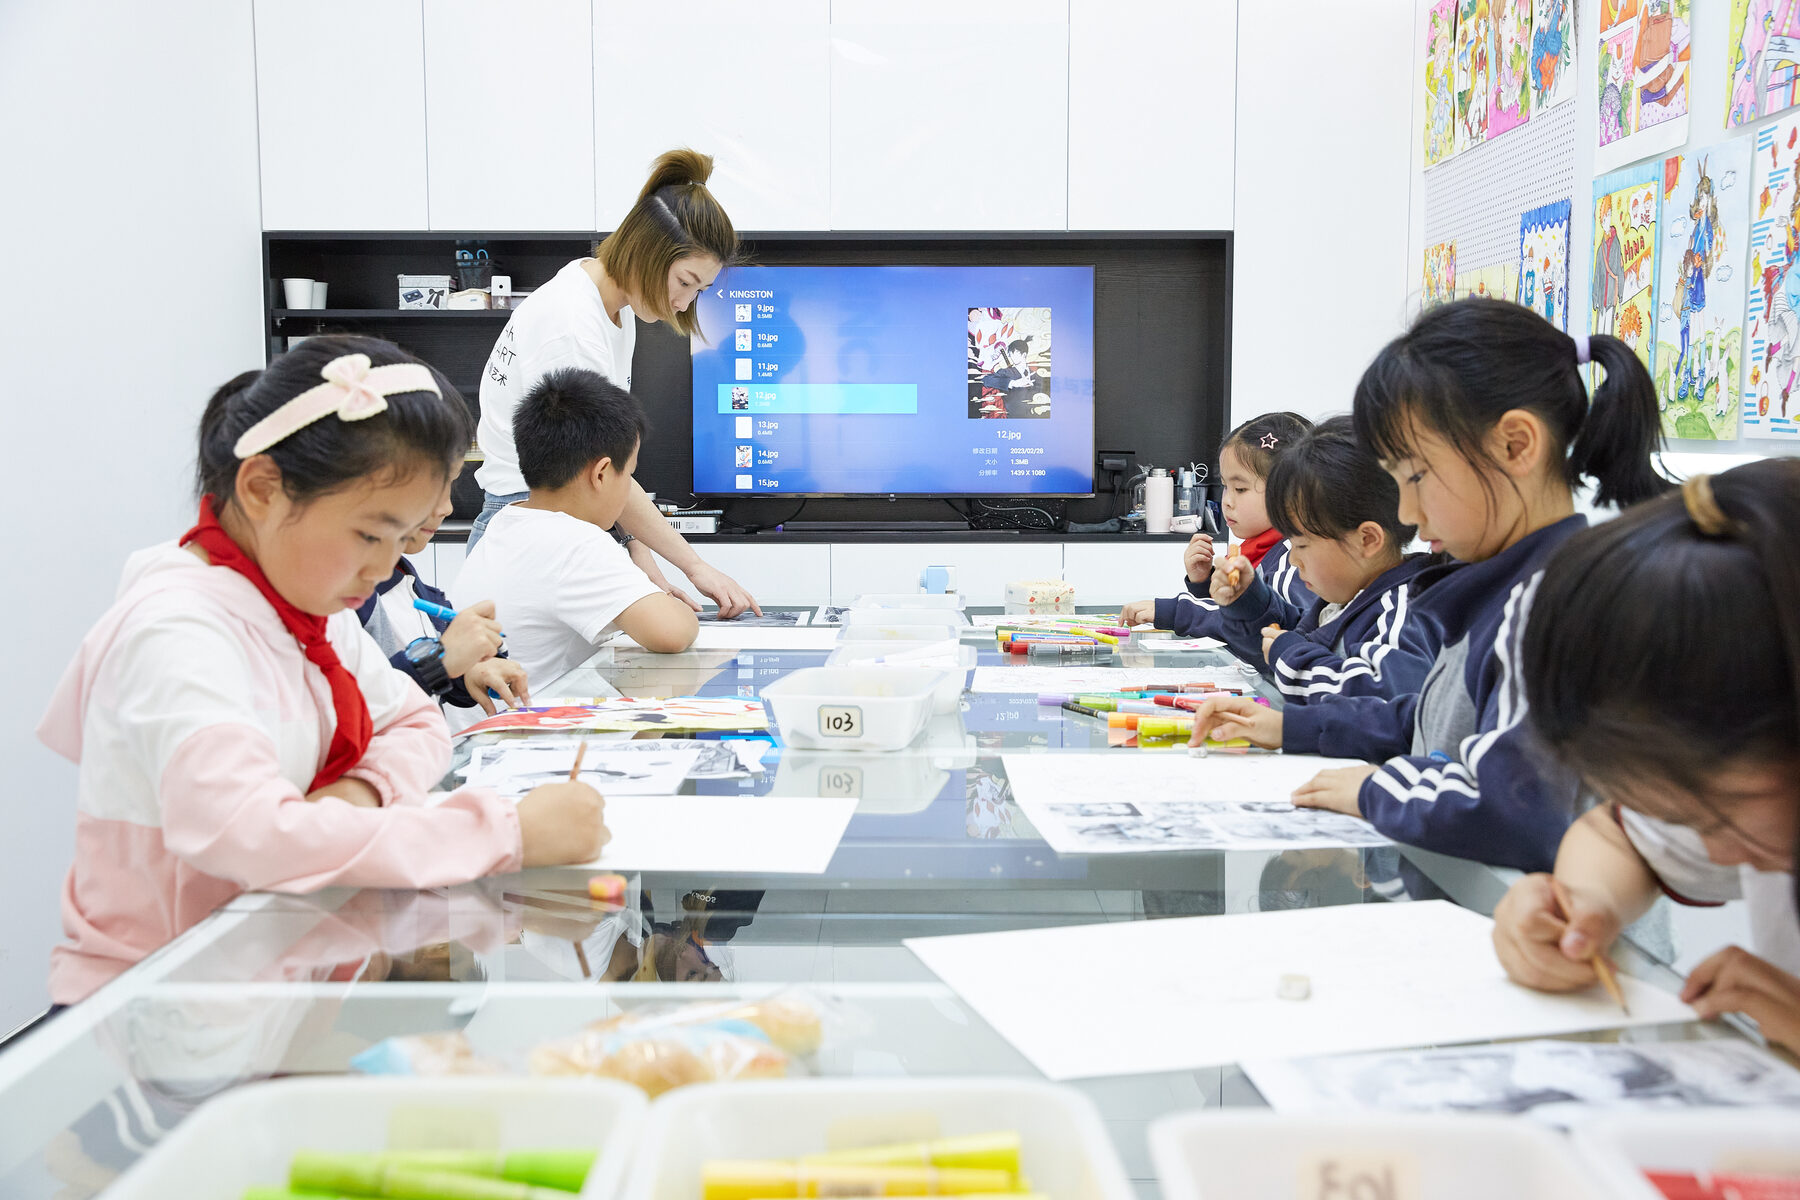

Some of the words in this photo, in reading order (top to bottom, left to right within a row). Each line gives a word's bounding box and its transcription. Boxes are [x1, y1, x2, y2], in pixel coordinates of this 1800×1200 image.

[729, 290, 774, 299] KINGSTON
[757, 304, 775, 313] 9.jpg
[757, 333, 779, 342] 10.jpg
[757, 362, 779, 371] 11.jpg
[754, 391, 777, 400] 12.jpg
[757, 420, 779, 430] 13.jpg
[996, 430, 1022, 440] 12.jpg
[757, 450, 779, 459] 14.jpg
[1010, 447, 1044, 455] 2023/02/28
[984, 458, 998, 466] 大小
[978, 469, 998, 477] 分辨率
[757, 479, 779, 489] 15.jpg
[827, 712, 854, 732] 103
